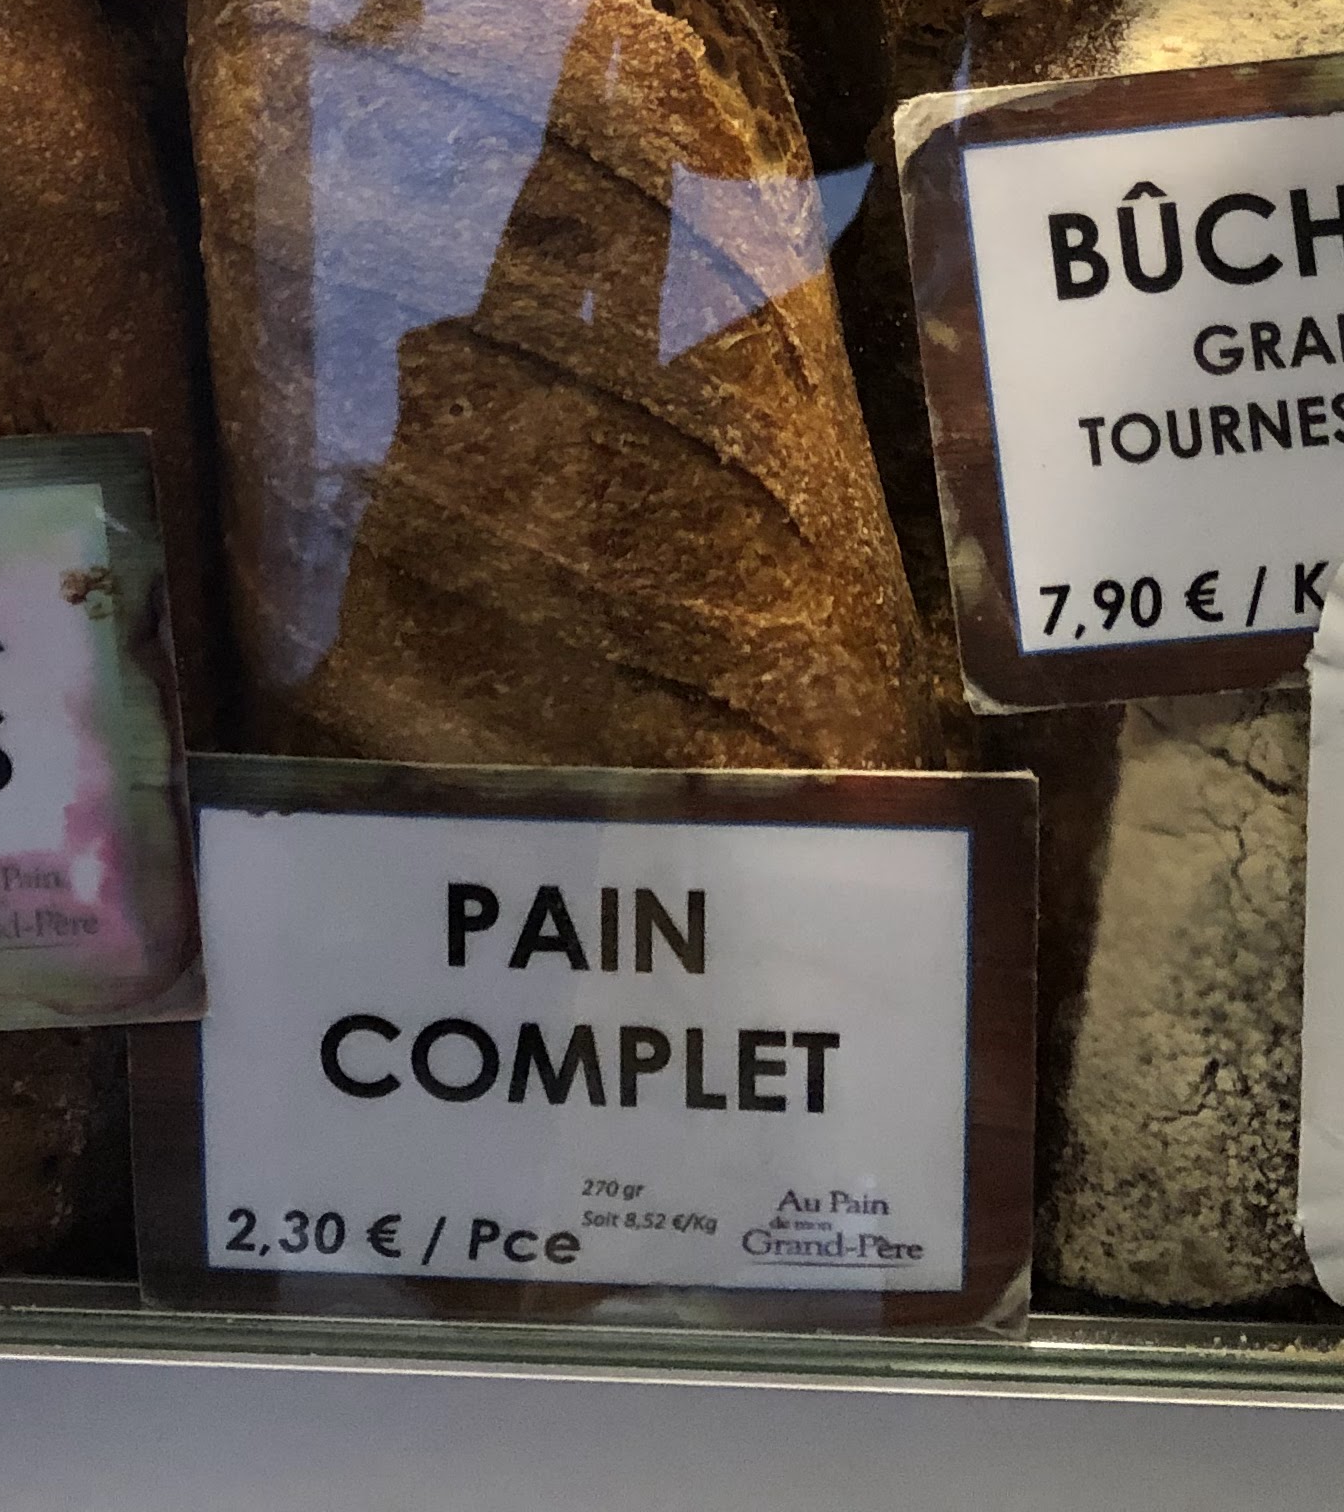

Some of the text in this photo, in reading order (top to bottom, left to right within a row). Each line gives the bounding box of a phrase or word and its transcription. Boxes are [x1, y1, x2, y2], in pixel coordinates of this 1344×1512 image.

[1040, 577, 1162, 639] 7,90
[1184, 570, 1223, 622] €
[1246, 566, 1267, 627] /
[447, 883, 705, 974] PAIN
[320, 1013, 840, 1113] COMPLET
[582, 1179, 644, 1201] 270 gr
[777, 1189, 889, 1215] Au Pain
[226, 1208, 581, 1265] 2,30 € / Pce
[582, 1210, 717, 1235] Soit 8,52 €/Kg
[742, 1228, 924, 1260] Grand-Père
